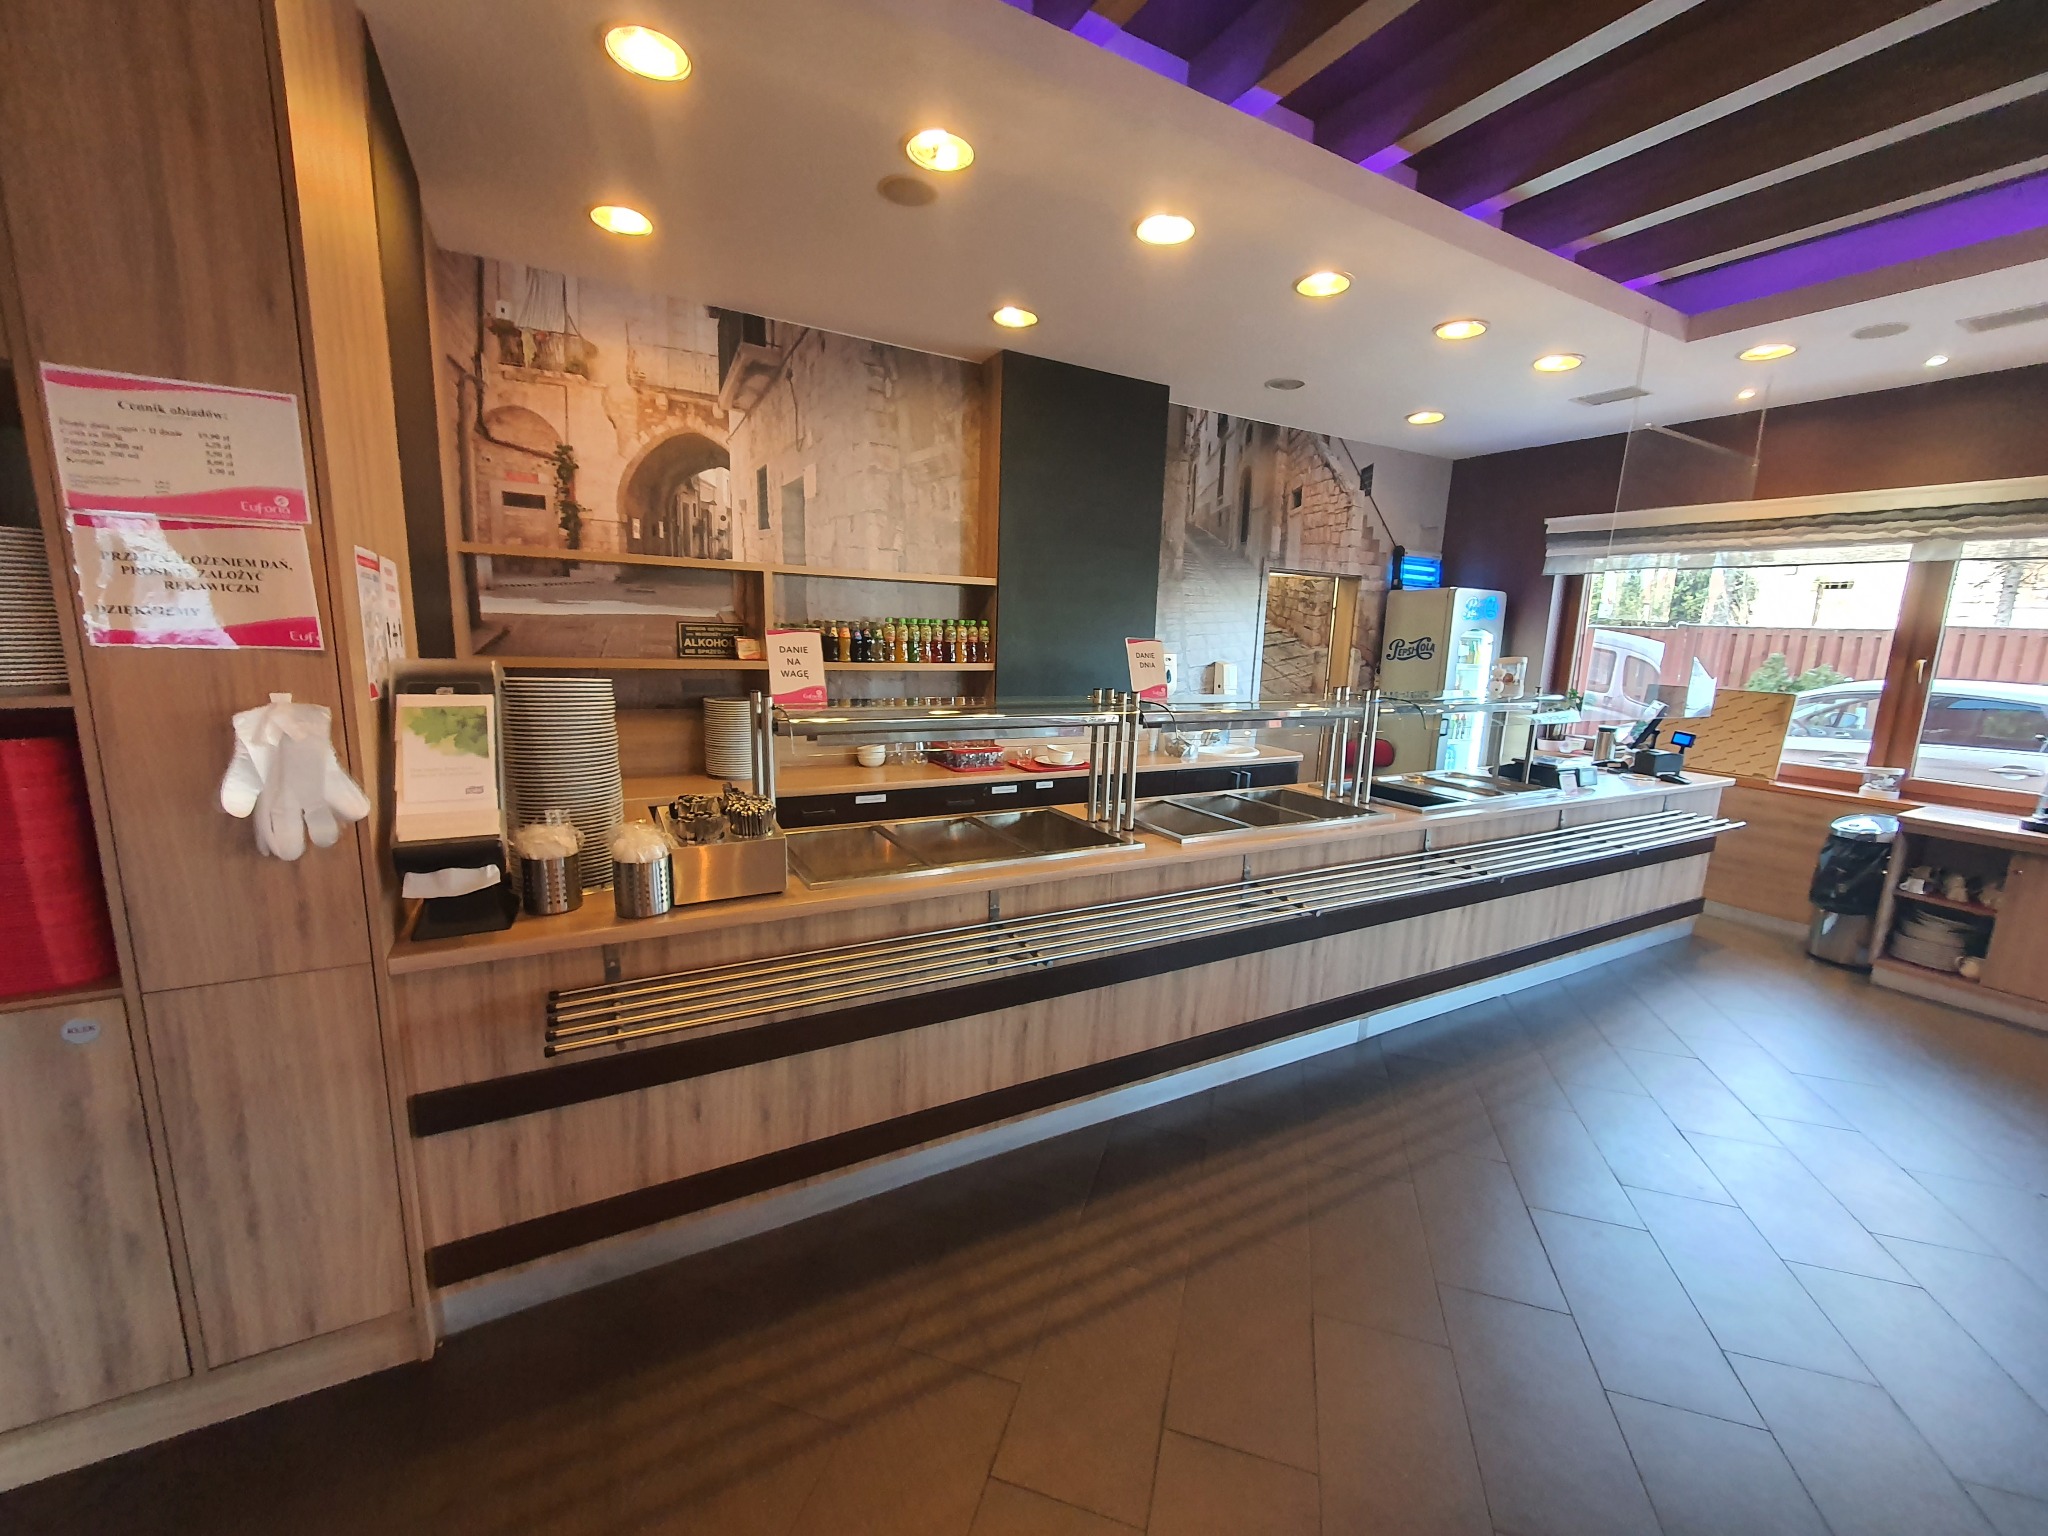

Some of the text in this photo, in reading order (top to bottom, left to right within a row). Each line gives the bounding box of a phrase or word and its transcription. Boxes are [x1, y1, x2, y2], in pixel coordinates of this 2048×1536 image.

[778, 645, 809, 654] DANIE
[786, 658, 801, 666] NA
[1139, 661, 1156, 669] DNIA
[780, 670, 810, 680] WAGĘ
